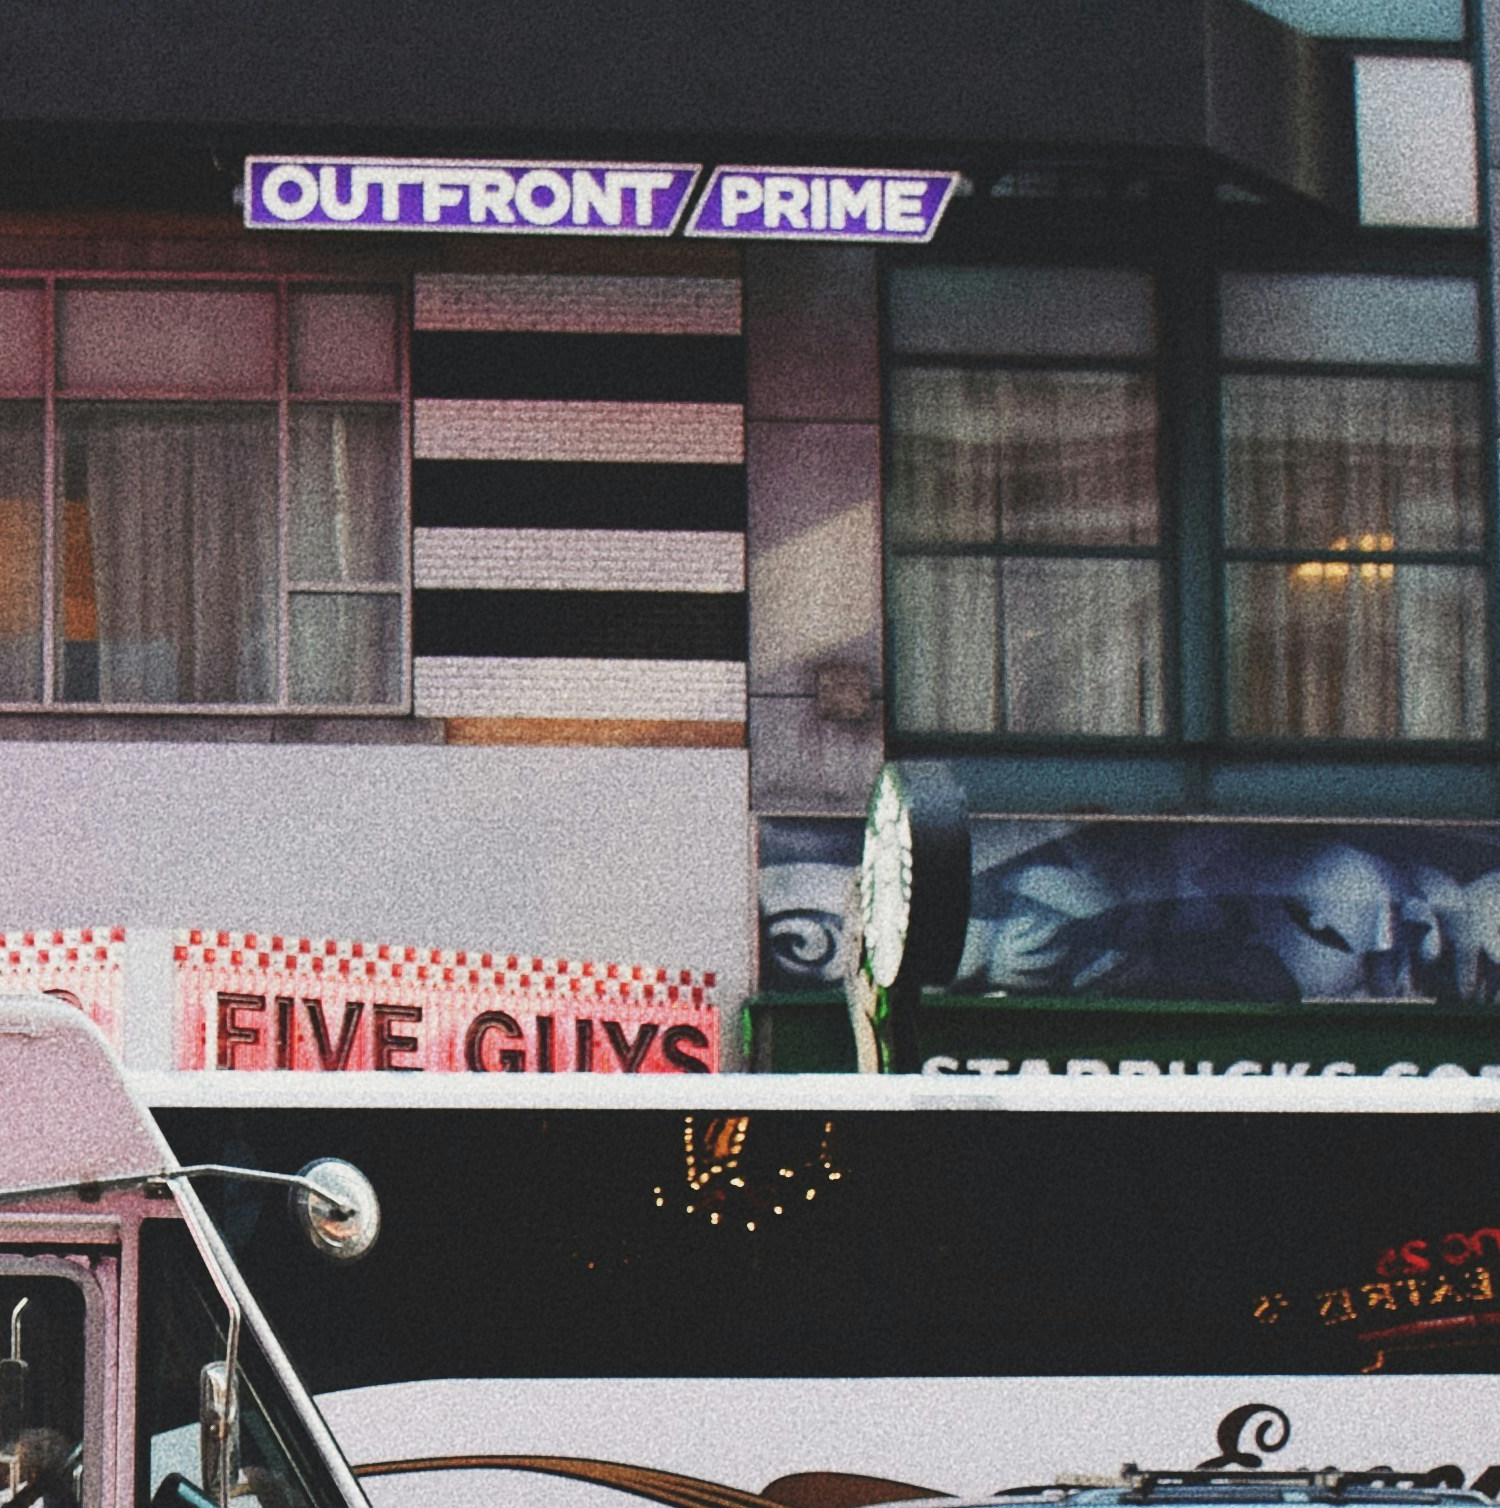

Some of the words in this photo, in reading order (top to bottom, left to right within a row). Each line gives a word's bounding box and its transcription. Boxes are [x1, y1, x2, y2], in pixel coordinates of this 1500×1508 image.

[260, 164, 673, 228] OUTFRONT
[720, 175, 928, 233] PRIME
[216, 990, 424, 1072] FIVE
[464, 1009, 711, 1074] GUYS
